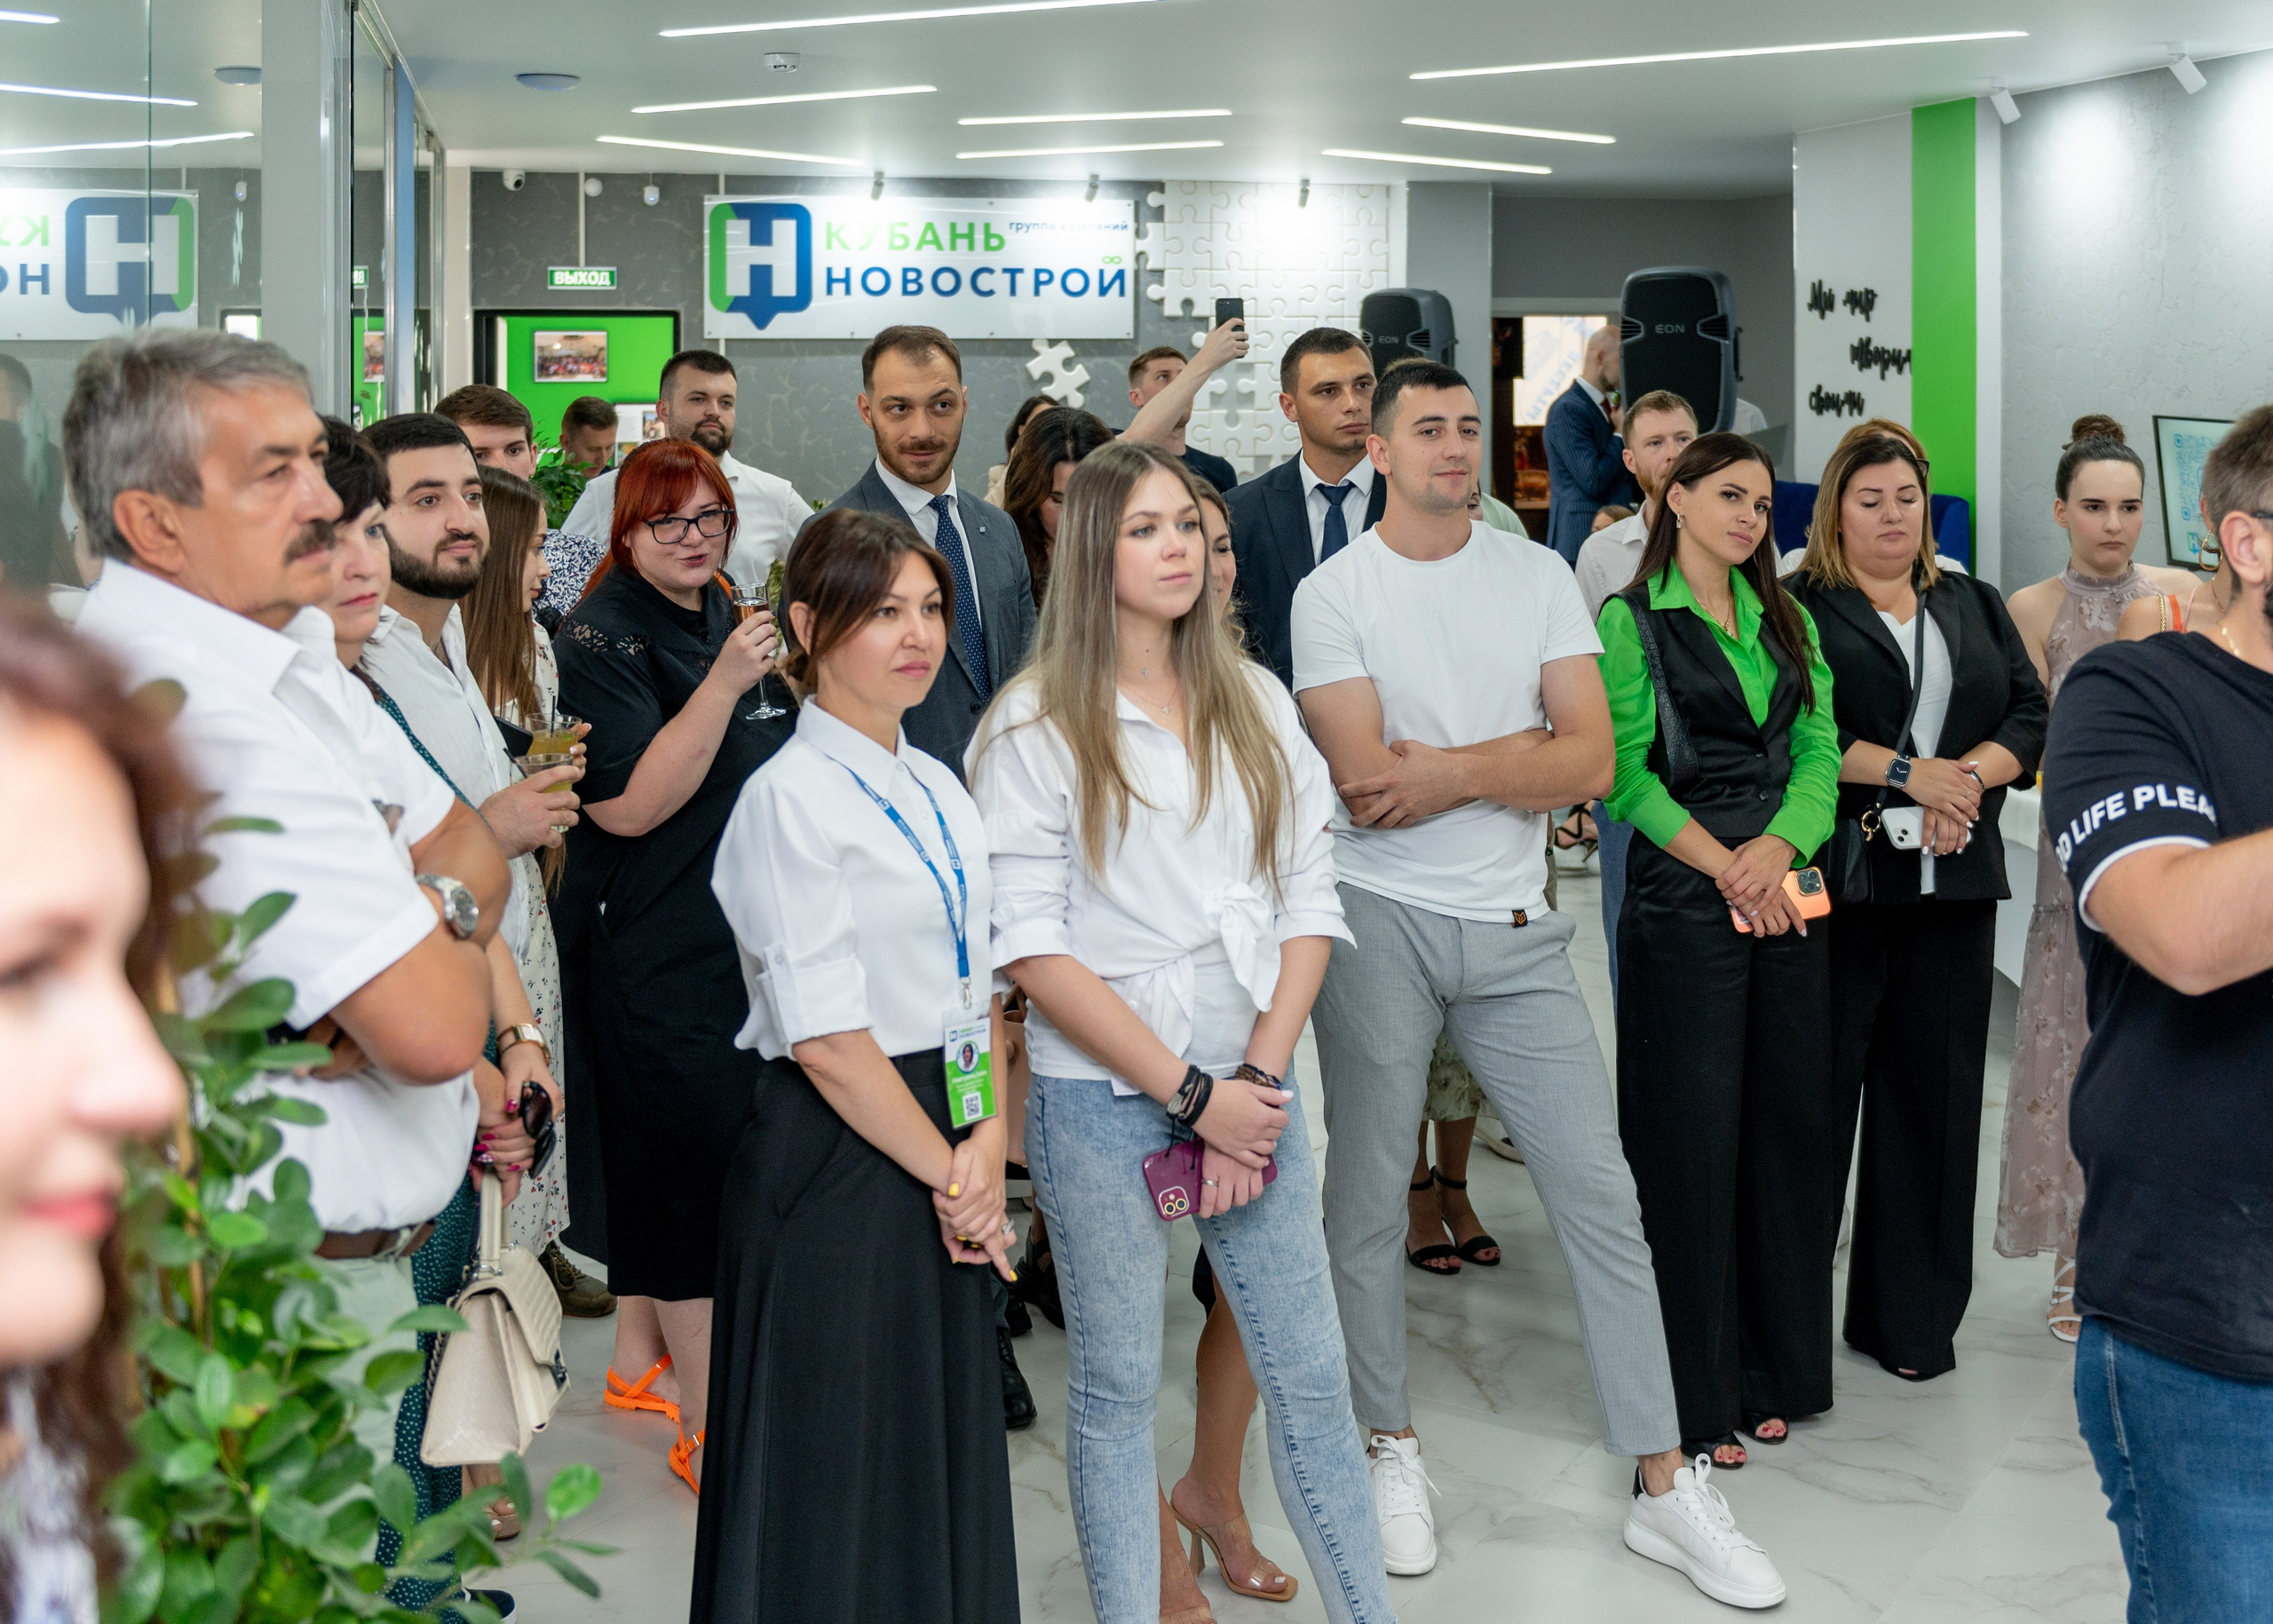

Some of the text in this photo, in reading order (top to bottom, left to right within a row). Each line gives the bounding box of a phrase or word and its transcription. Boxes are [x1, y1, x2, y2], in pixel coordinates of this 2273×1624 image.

[1009, 222, 1056, 234] группа
[826, 221, 1006, 252] КУБАНЬ
[553, 271, 611, 286] ВЫХОД
[1655, 324, 1685, 334] EON
[2070, 791, 2127, 845] LIFE
[2133, 783, 2217, 827] PLEA
